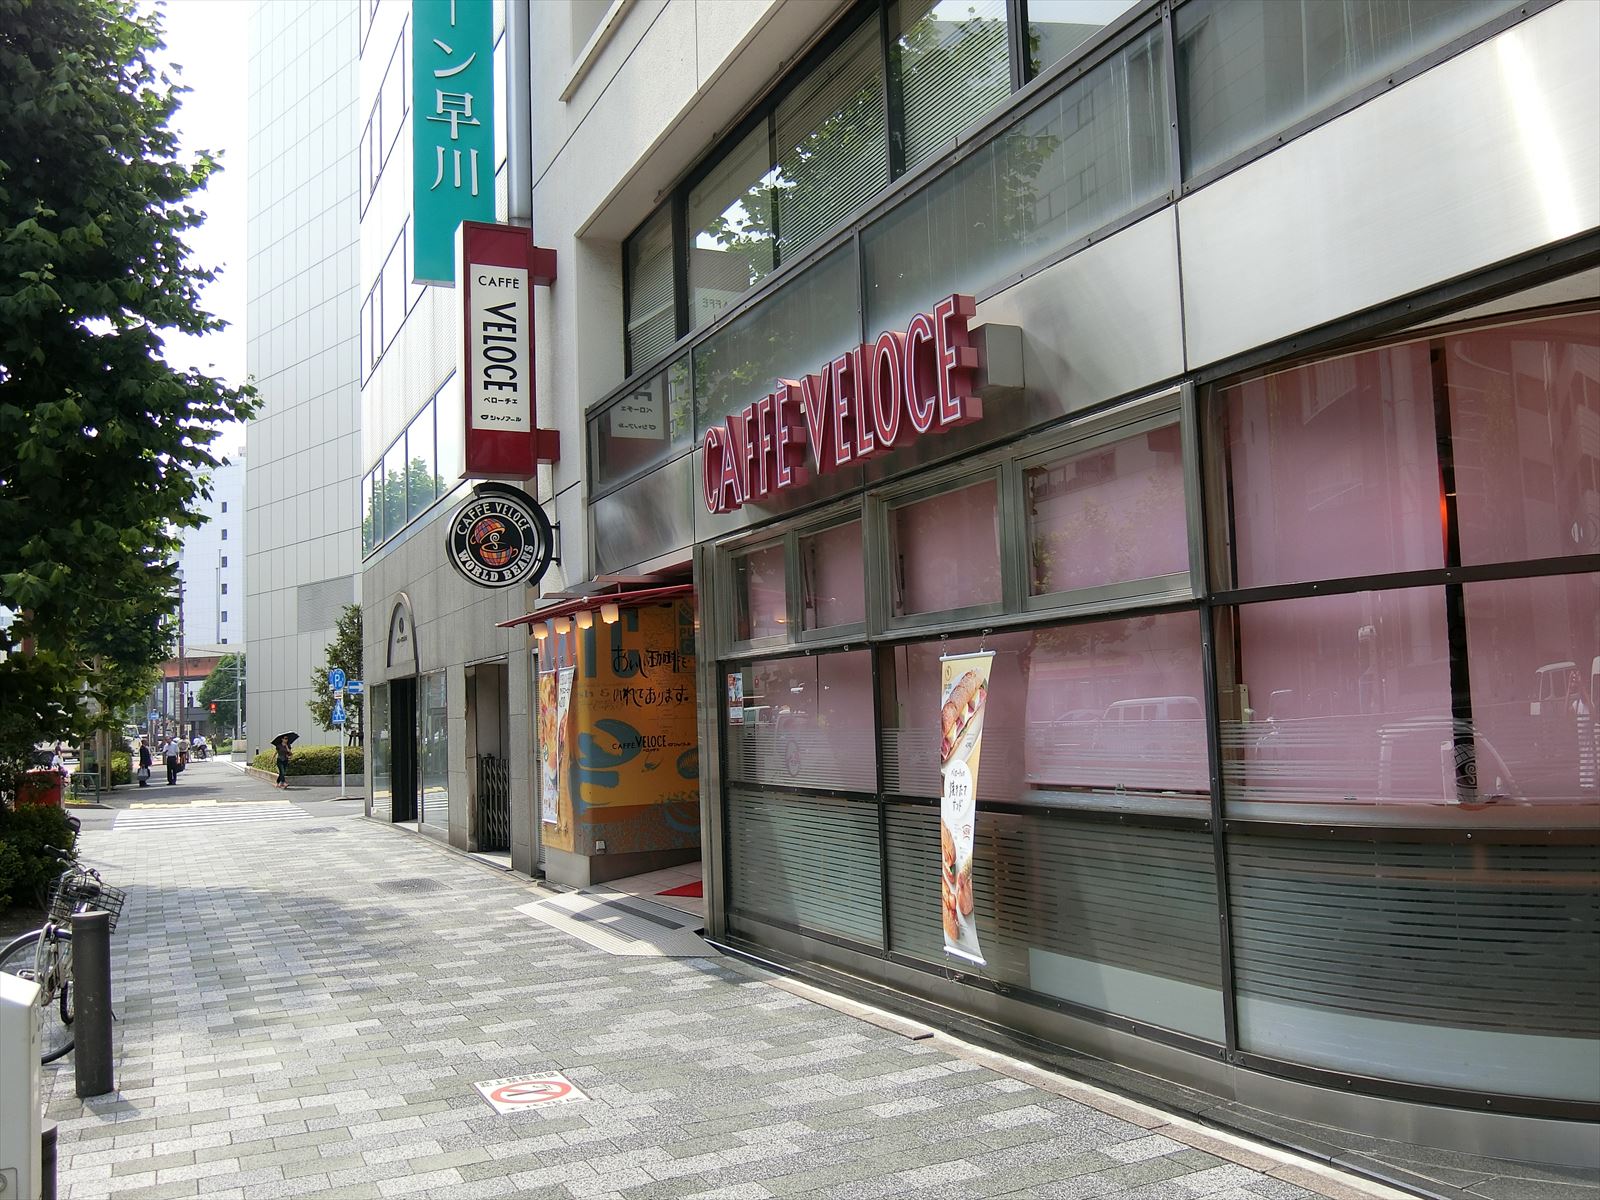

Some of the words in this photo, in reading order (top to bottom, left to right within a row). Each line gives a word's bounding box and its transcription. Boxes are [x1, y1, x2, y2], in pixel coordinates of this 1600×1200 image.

[482, 301, 518, 393] VELOCE
[483, 396, 518, 405] ベローチェ
[702, 377, 803, 514] CAFFÈ
[800, 293, 980, 475] VELOCE
[495, 502, 531, 532] VELOCE
[457, 549, 499, 582] WORLD
[502, 544, 534, 580] BEANS
[635, 734, 667, 748] VELOCE
